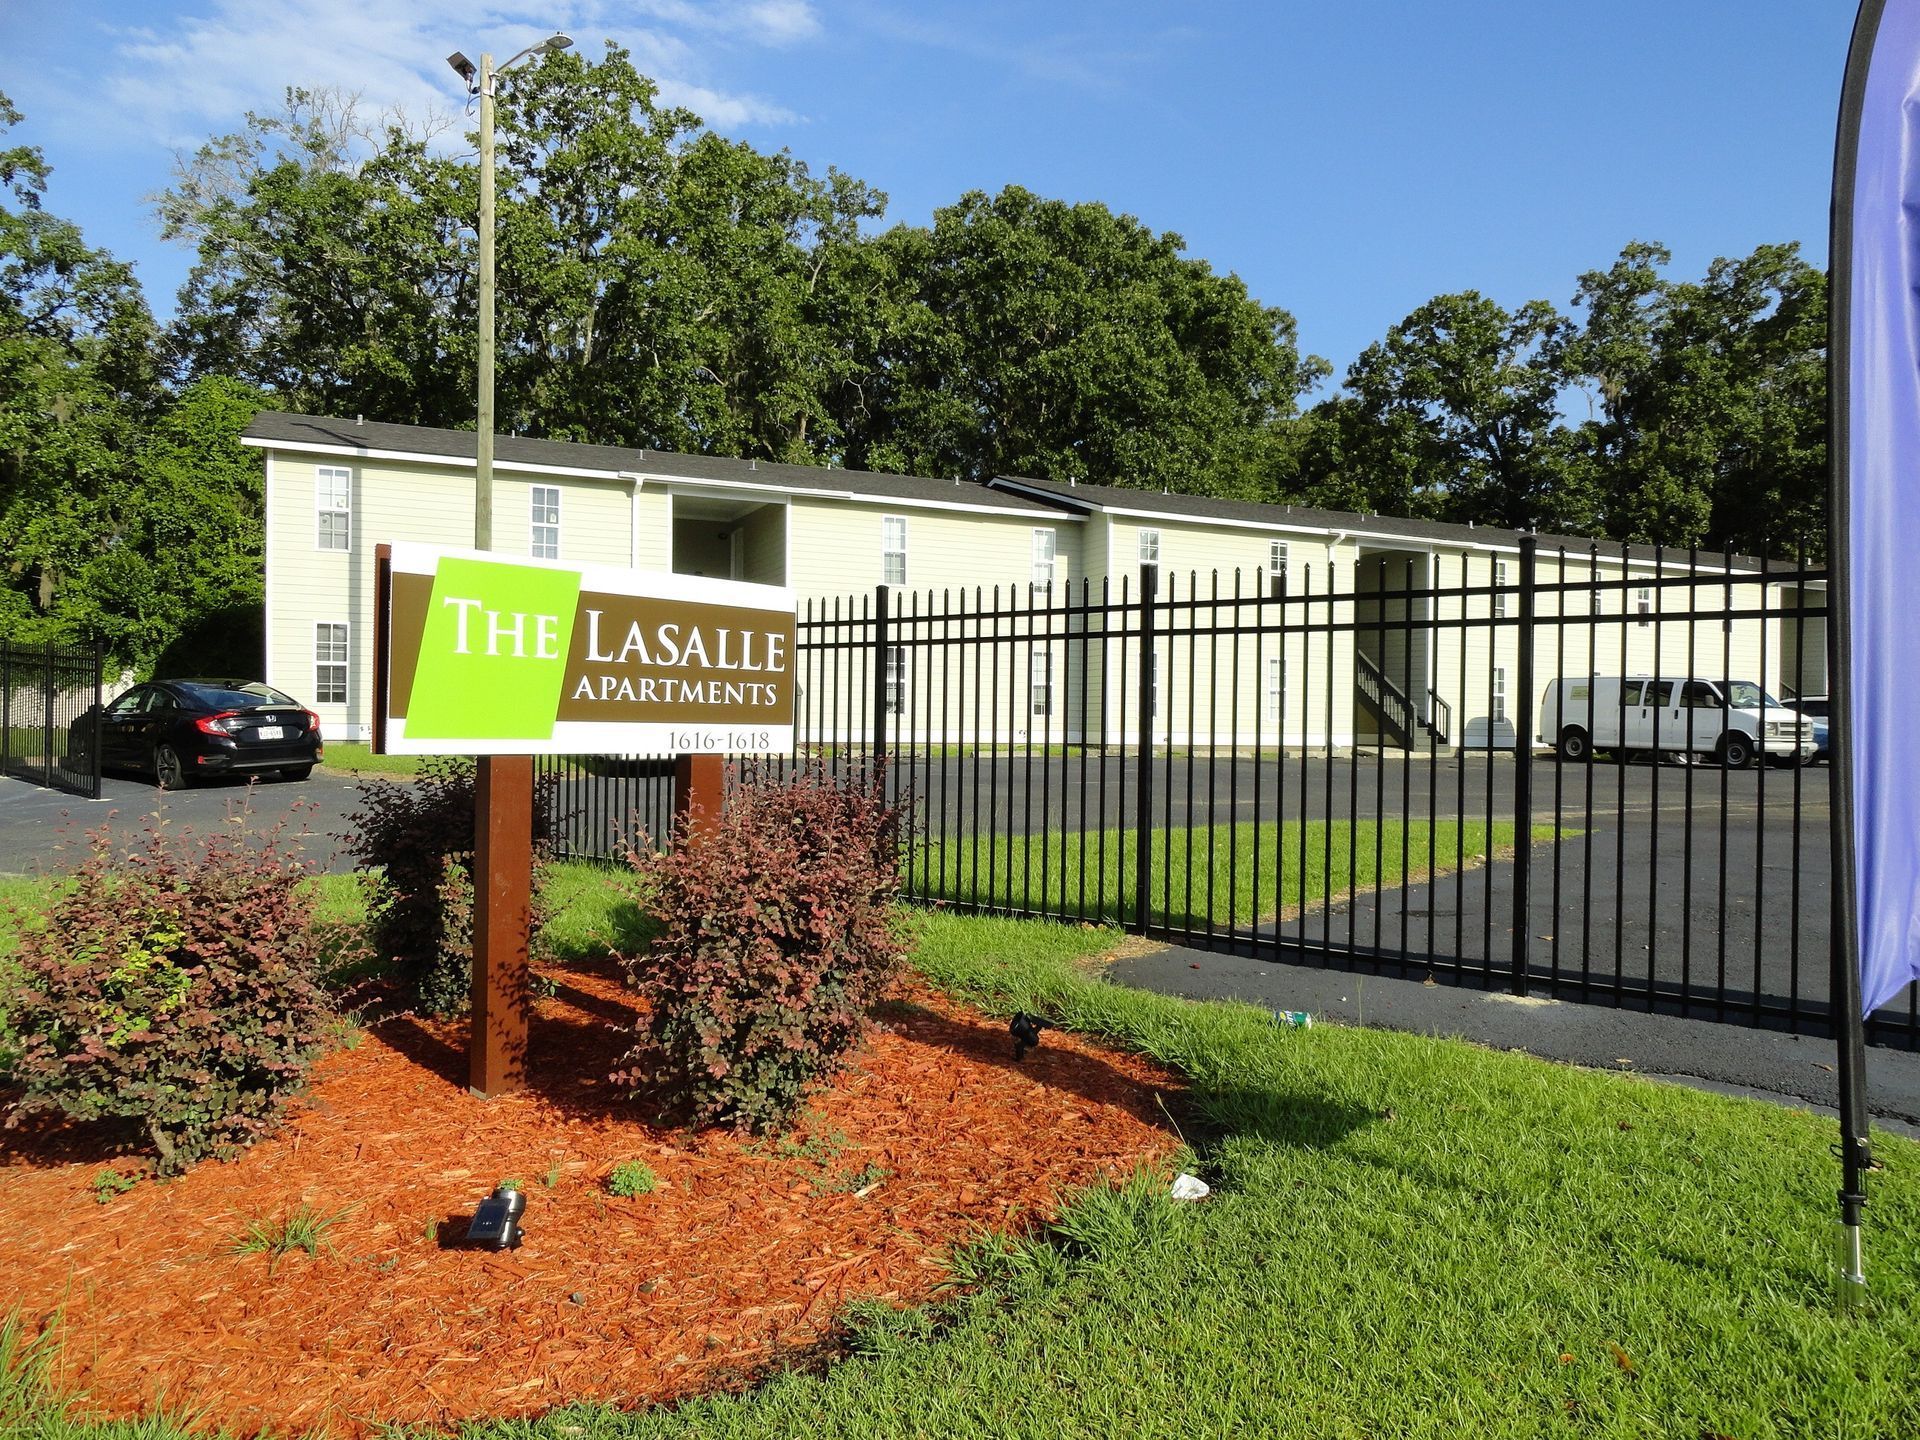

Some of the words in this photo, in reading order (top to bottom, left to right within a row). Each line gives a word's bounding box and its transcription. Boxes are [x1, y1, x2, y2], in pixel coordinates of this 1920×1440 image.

[443, 595, 559, 660] THE
[585, 609, 785, 673] LASALLE
[571, 674, 777, 706] APARTMENTS
[669, 731, 770, 750] 1616-1618
